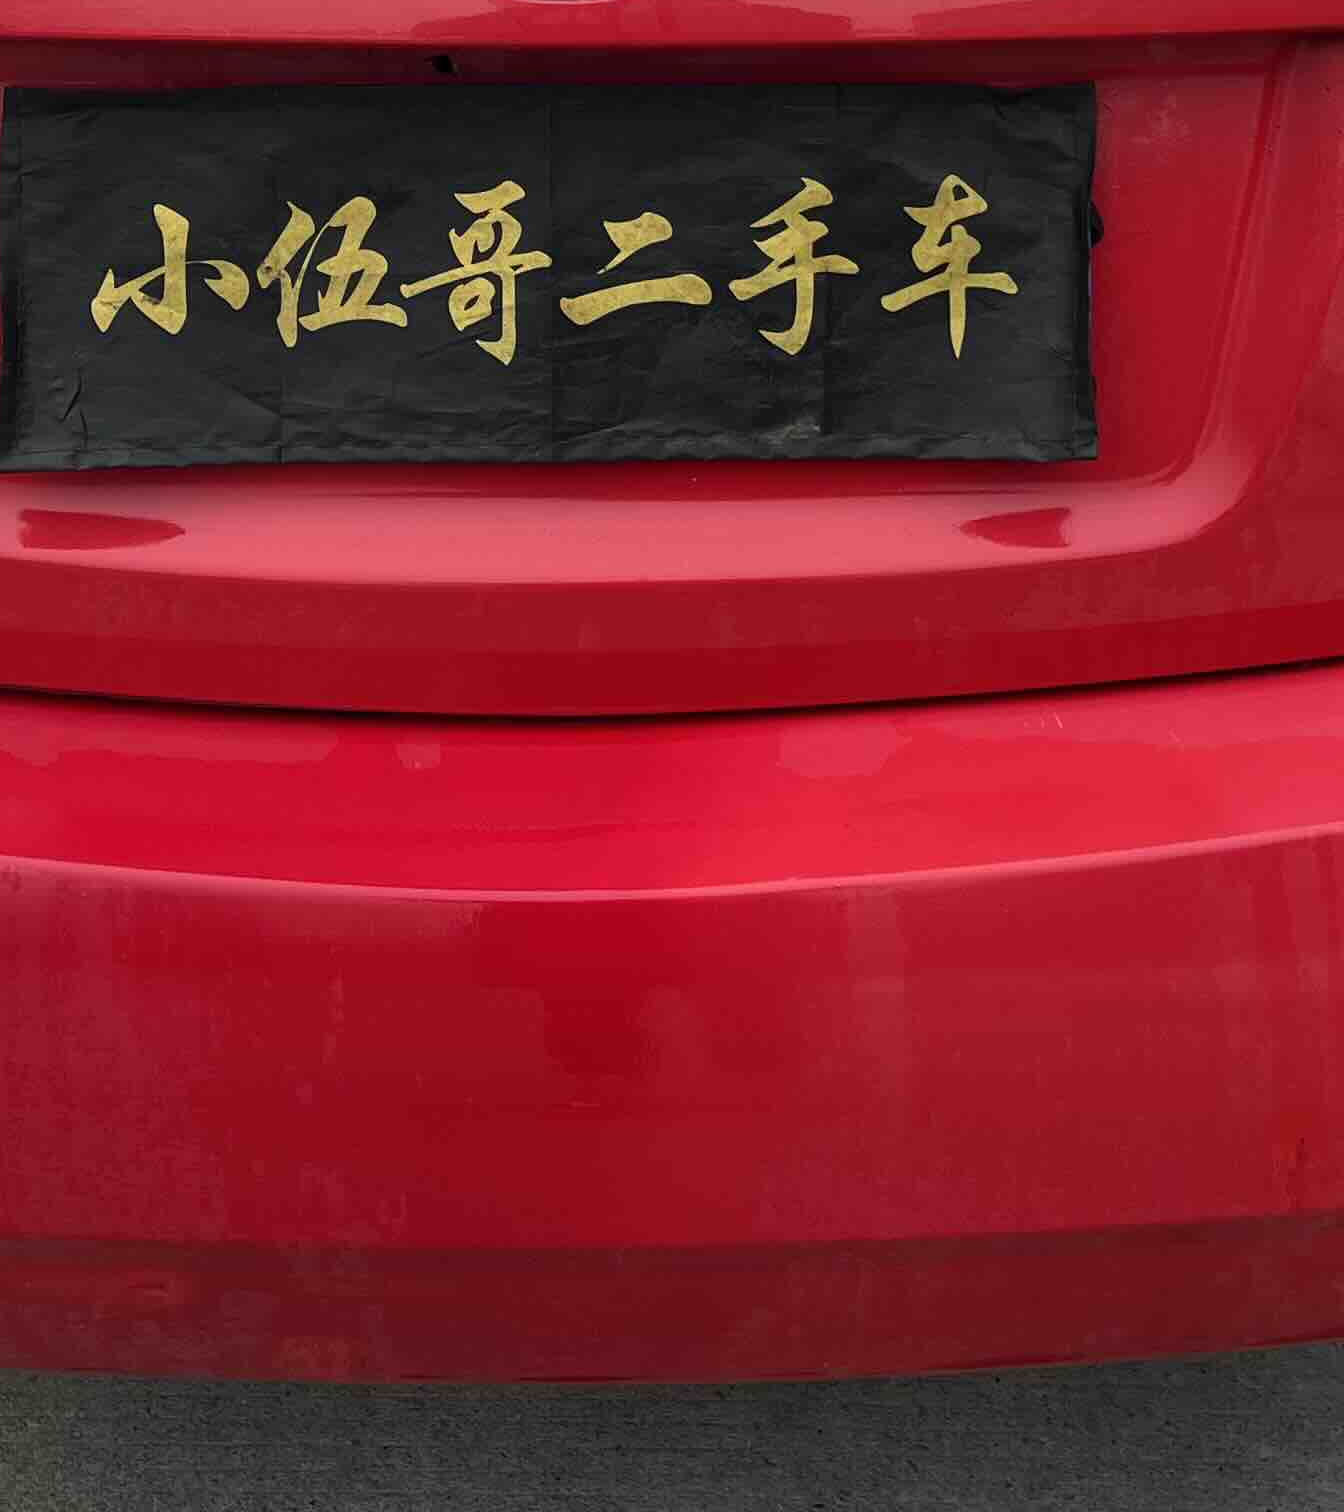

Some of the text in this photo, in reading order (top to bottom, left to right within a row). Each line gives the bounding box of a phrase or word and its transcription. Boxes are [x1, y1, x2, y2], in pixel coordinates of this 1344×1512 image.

[92, 175, 1018, 365] 小伍哥二手车
